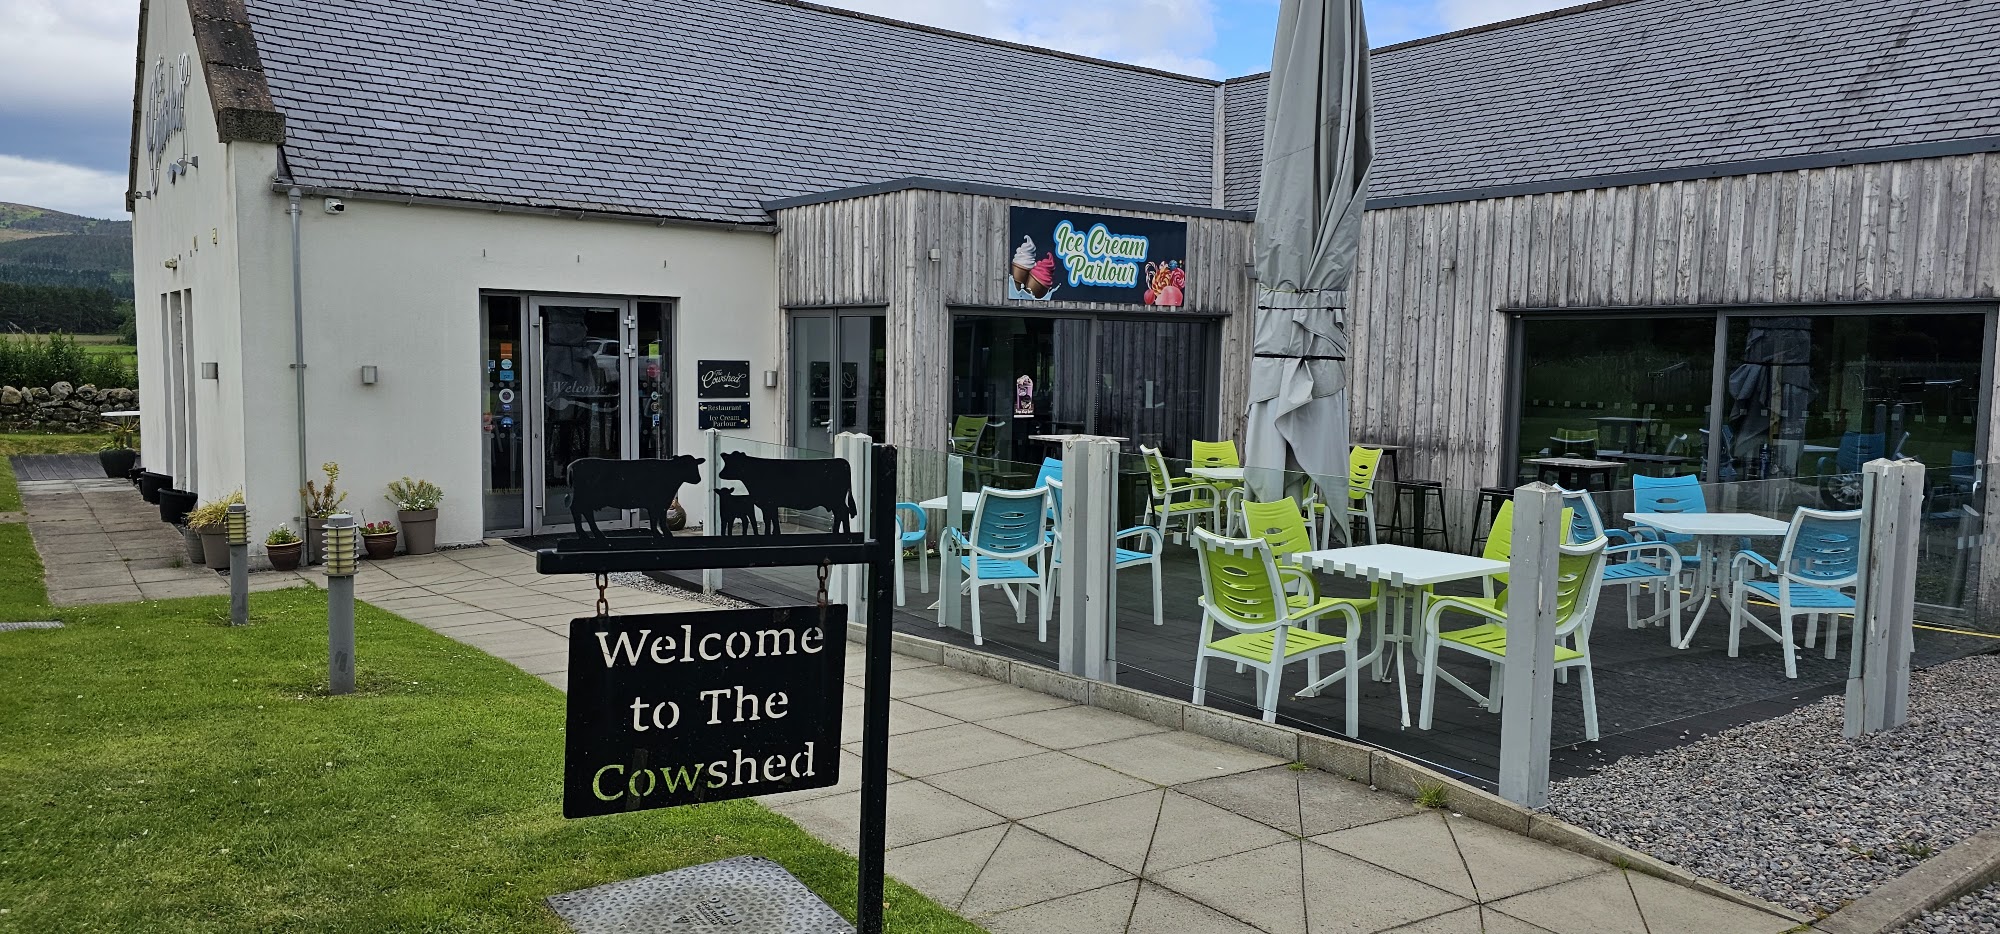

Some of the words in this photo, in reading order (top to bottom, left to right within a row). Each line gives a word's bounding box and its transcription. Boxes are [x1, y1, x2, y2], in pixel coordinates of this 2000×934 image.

[1056, 224, 1085, 254] Ice
[1088, 227, 1147, 258] Cream
[1067, 253, 1136, 283] Parlour
[552, 380, 607, 393] Welcome
[702, 371, 747, 388] Cowshed
[595, 624, 824, 668] Welcome
[630, 696, 680, 732] to
[700, 686, 788, 725] The
[592, 741, 815, 801] Cowshed
